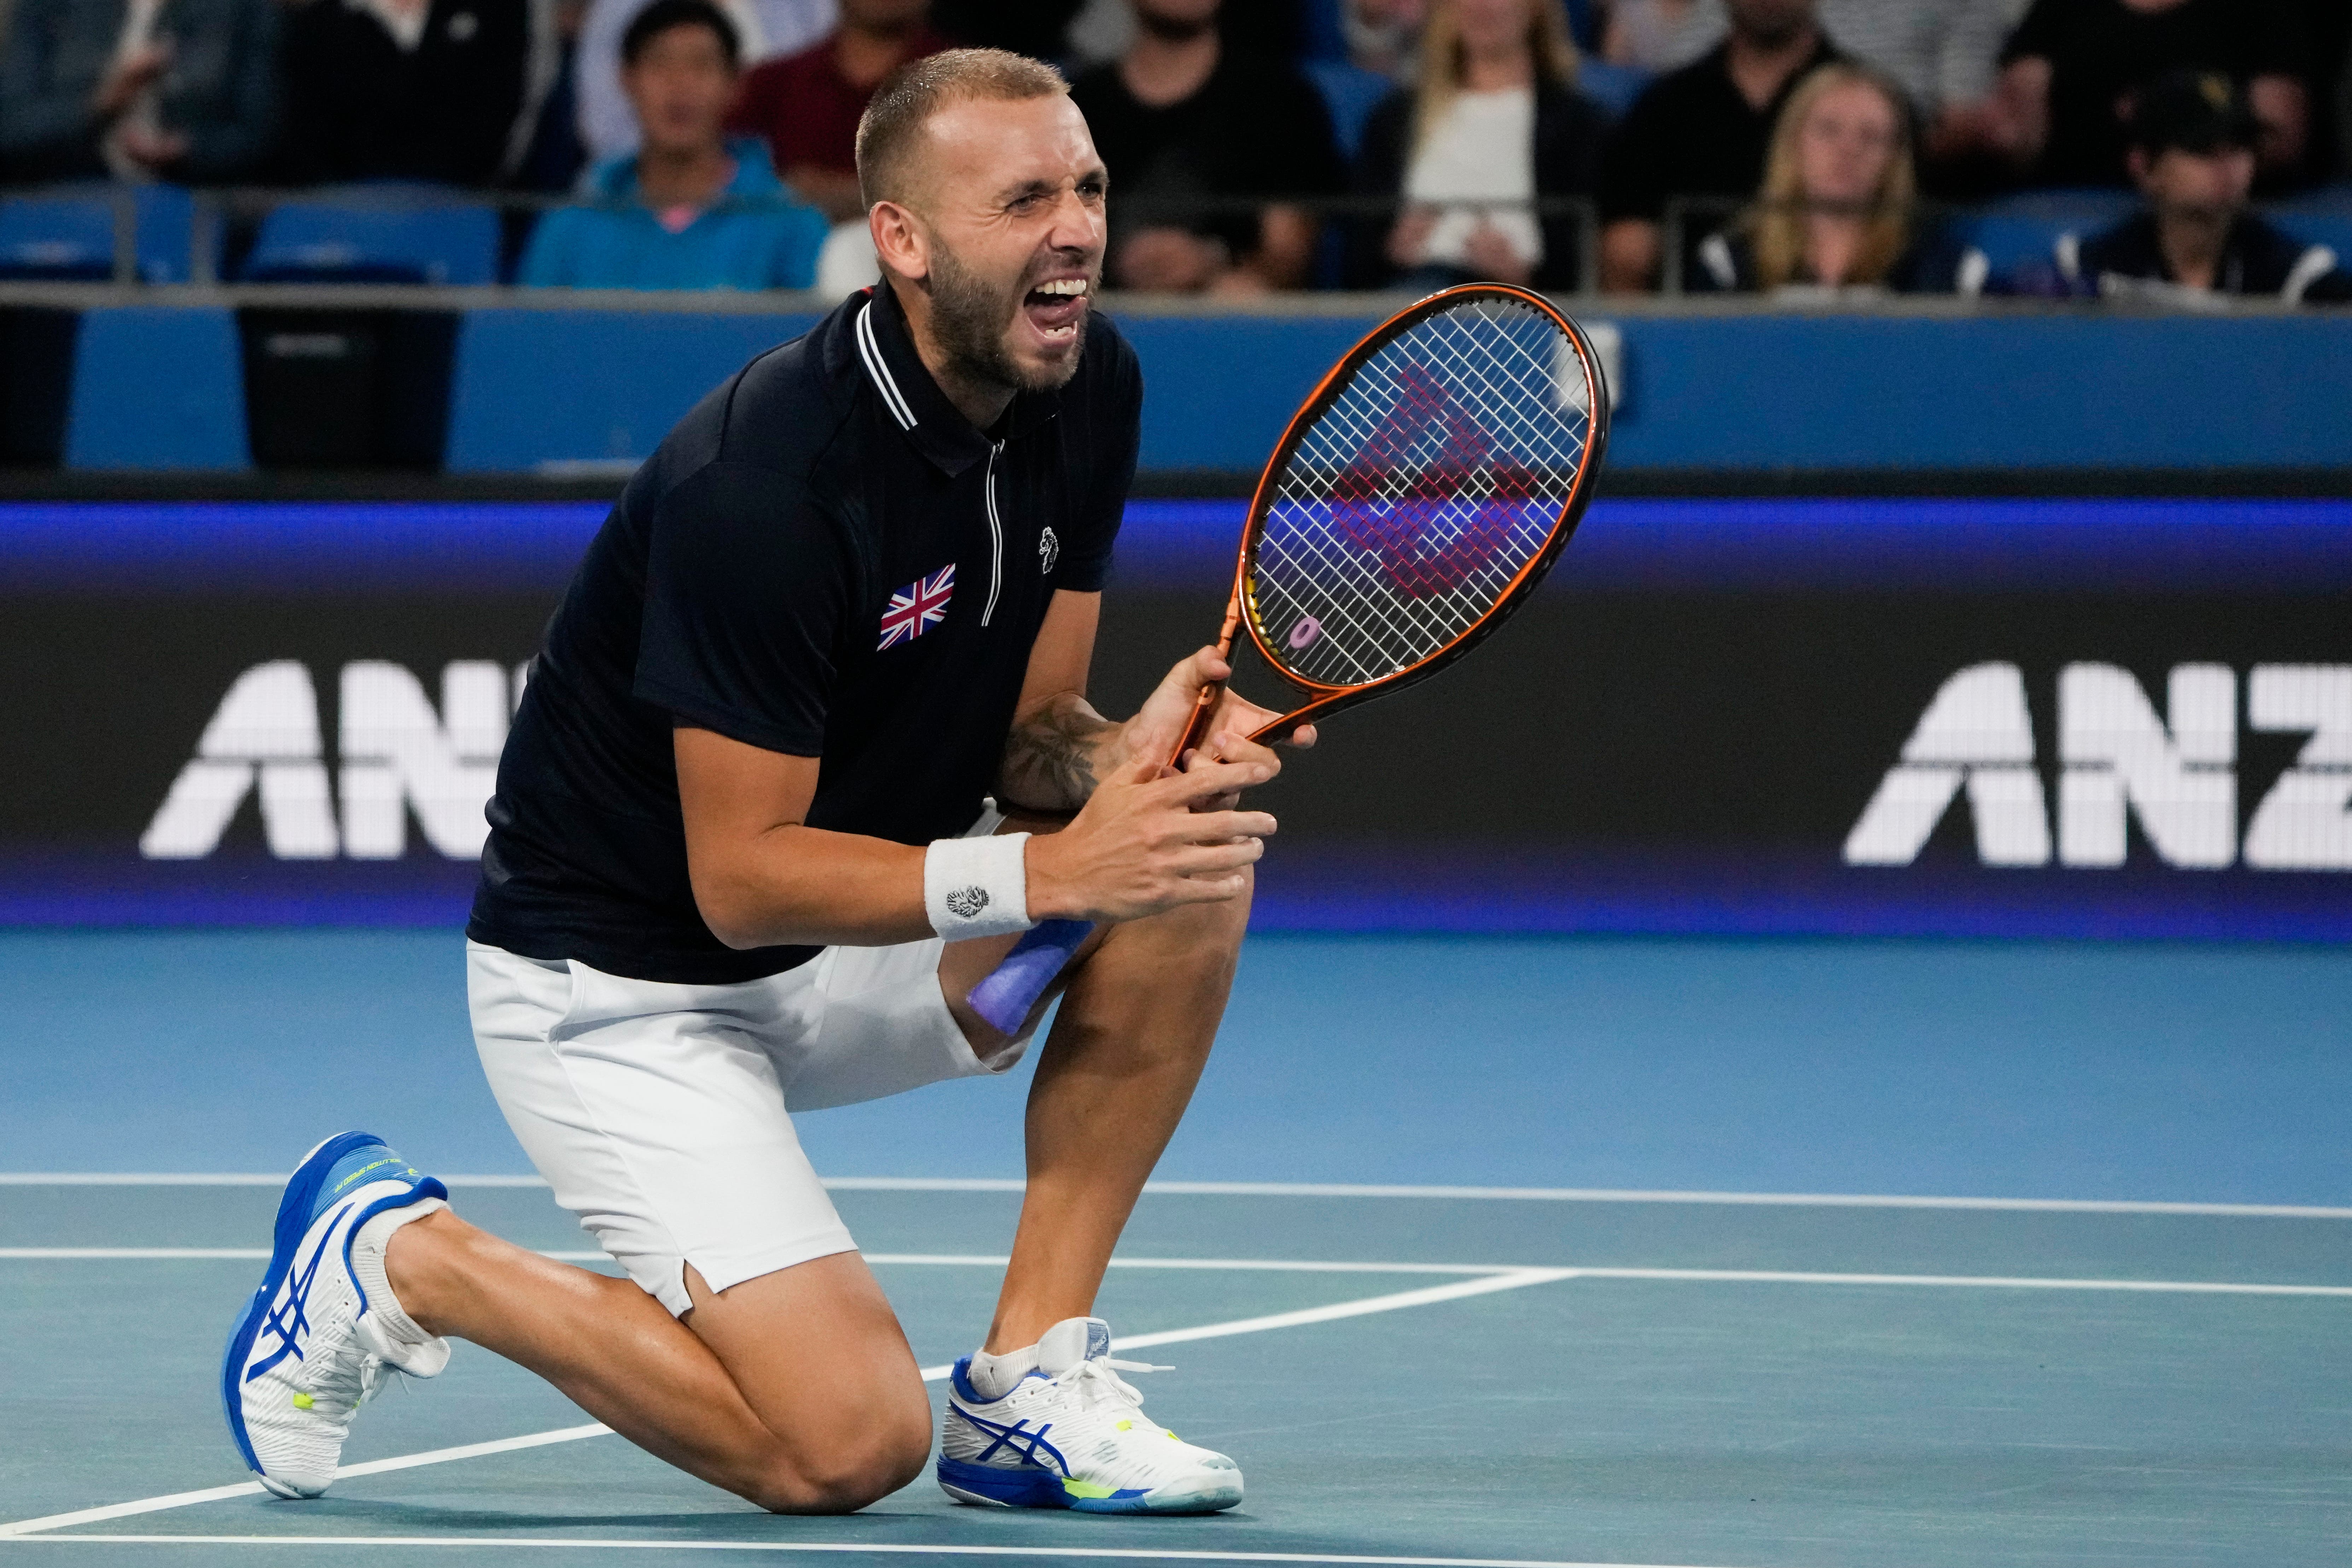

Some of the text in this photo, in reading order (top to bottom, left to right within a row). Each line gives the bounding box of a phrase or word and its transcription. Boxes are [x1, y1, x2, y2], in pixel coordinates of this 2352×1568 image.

[139, 658, 529, 860] AN
[1841, 660, 2352, 872] ANZ
[334, 1159, 401, 1193] SOLUTION SPEED FF
